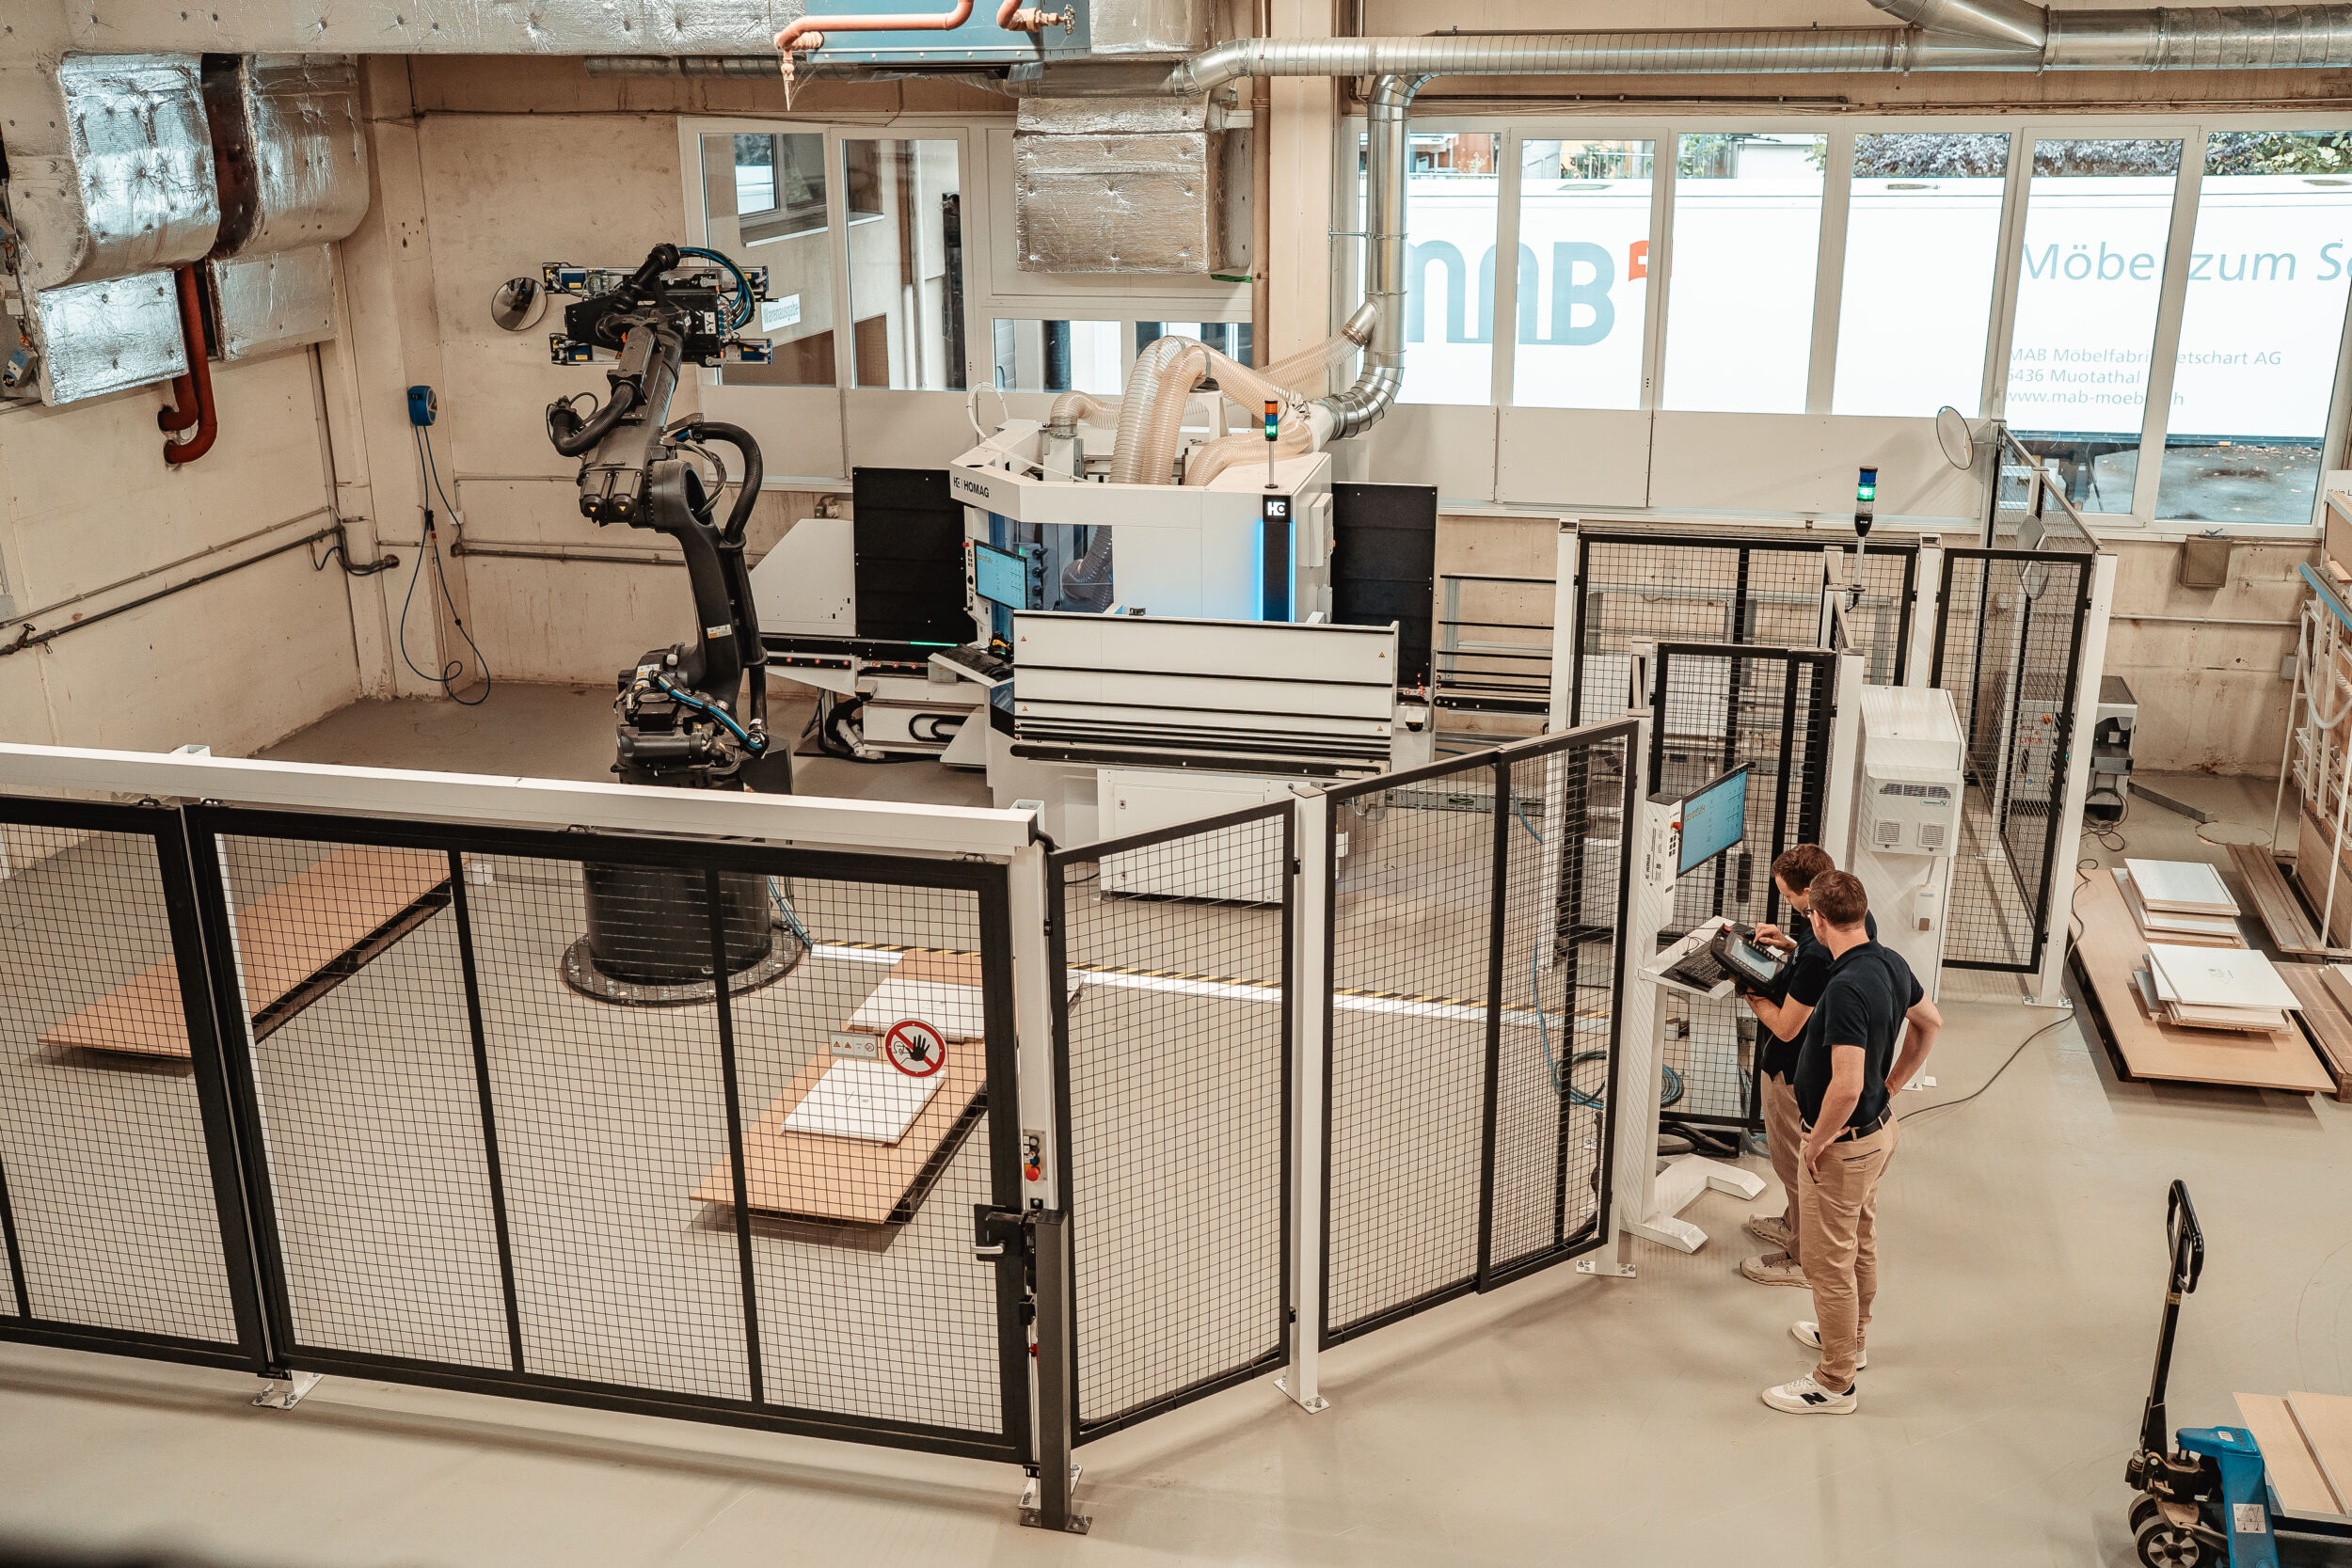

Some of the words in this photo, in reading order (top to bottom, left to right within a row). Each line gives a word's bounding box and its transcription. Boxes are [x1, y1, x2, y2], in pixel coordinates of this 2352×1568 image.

[2188, 252, 2296, 281] zum
[2010, 348, 2046, 361] MAB
[2053, 348, 2150, 363] Möbelfabri
[2176, 350, 2249, 365] etschart
[2254, 351, 2281, 365] AG
[2050, 369, 2140, 384] Muotathal
[963, 479, 990, 499] HOMAG
